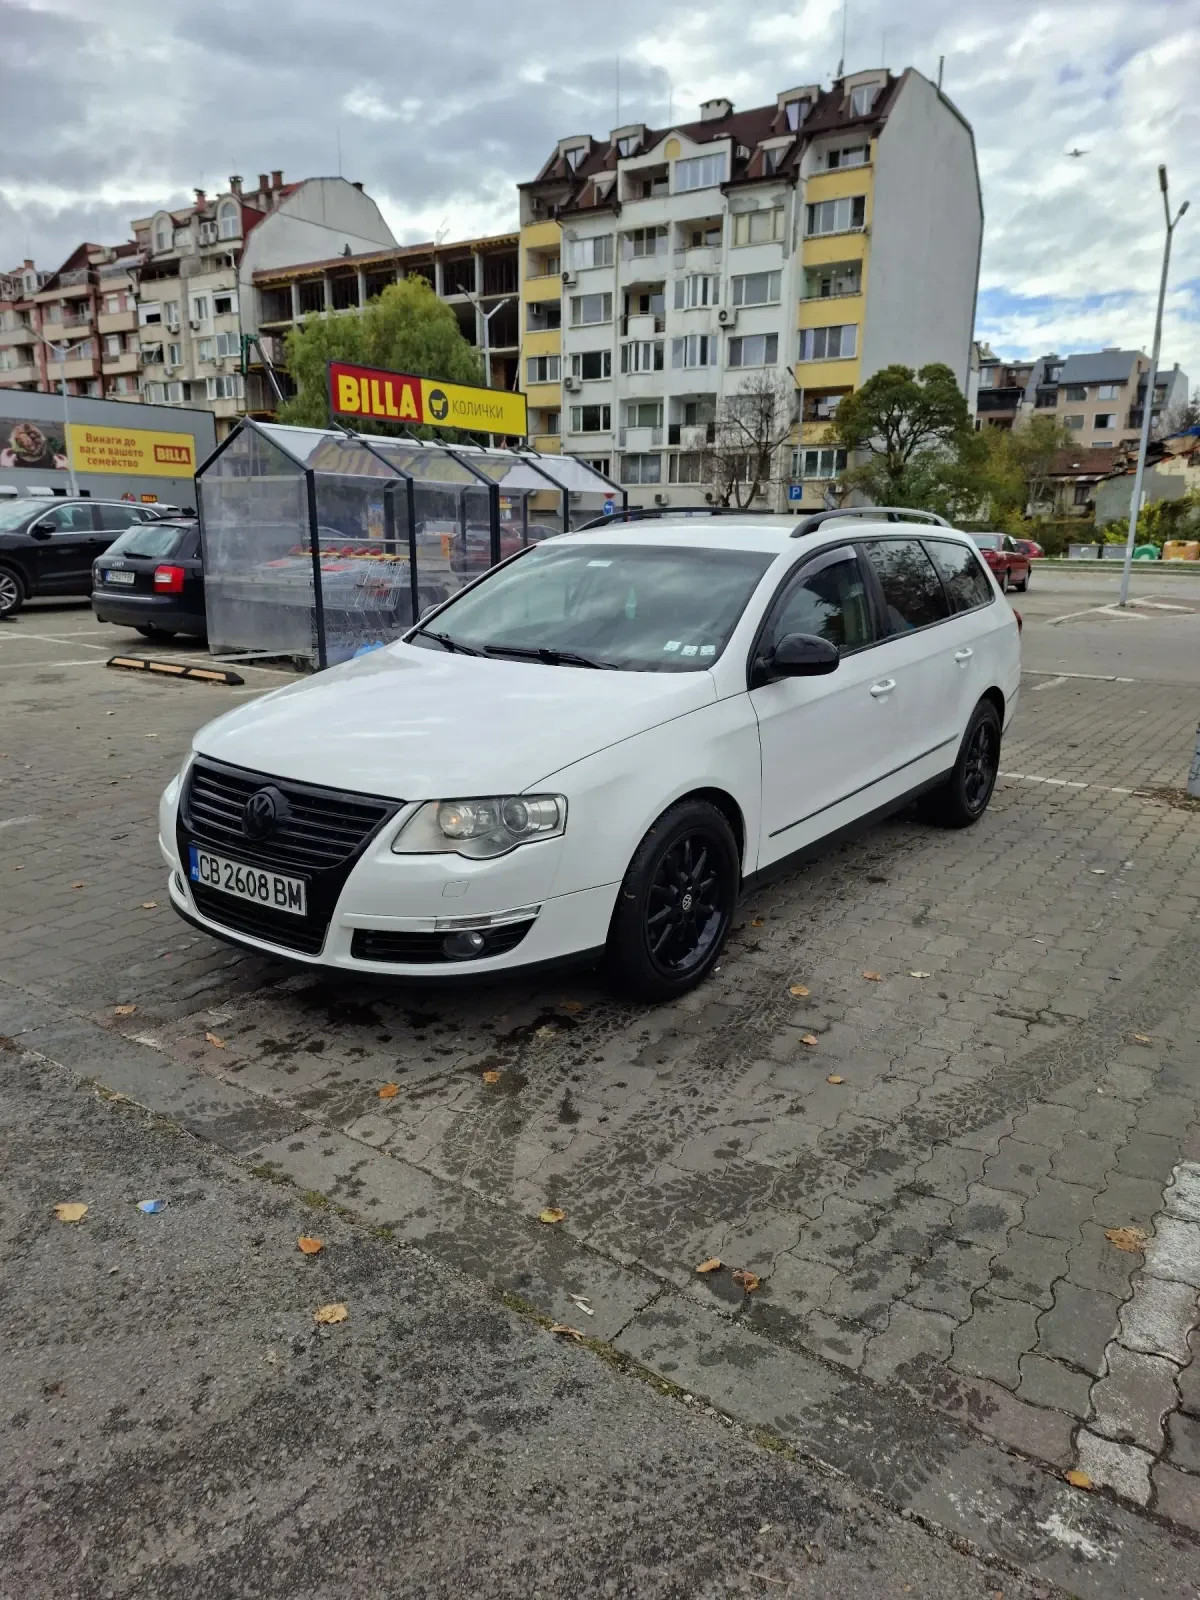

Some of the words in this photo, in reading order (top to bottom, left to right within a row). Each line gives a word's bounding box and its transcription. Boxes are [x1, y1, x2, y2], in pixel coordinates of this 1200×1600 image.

[337, 374, 418, 419] BILLA
[452, 400, 503, 419] КОЛИЧКИ
[86, 433, 122, 445] Винаги
[80, 446, 96, 454] вас
[108, 448, 143, 457] вашето
[157, 448, 188, 462] BILLA
[87, 457, 139, 468] семейство
[792, 487, 800, 499] P
[200, 854, 221, 885] CB
[224, 862, 269, 901] 2608
[274, 877, 302, 911] BM
